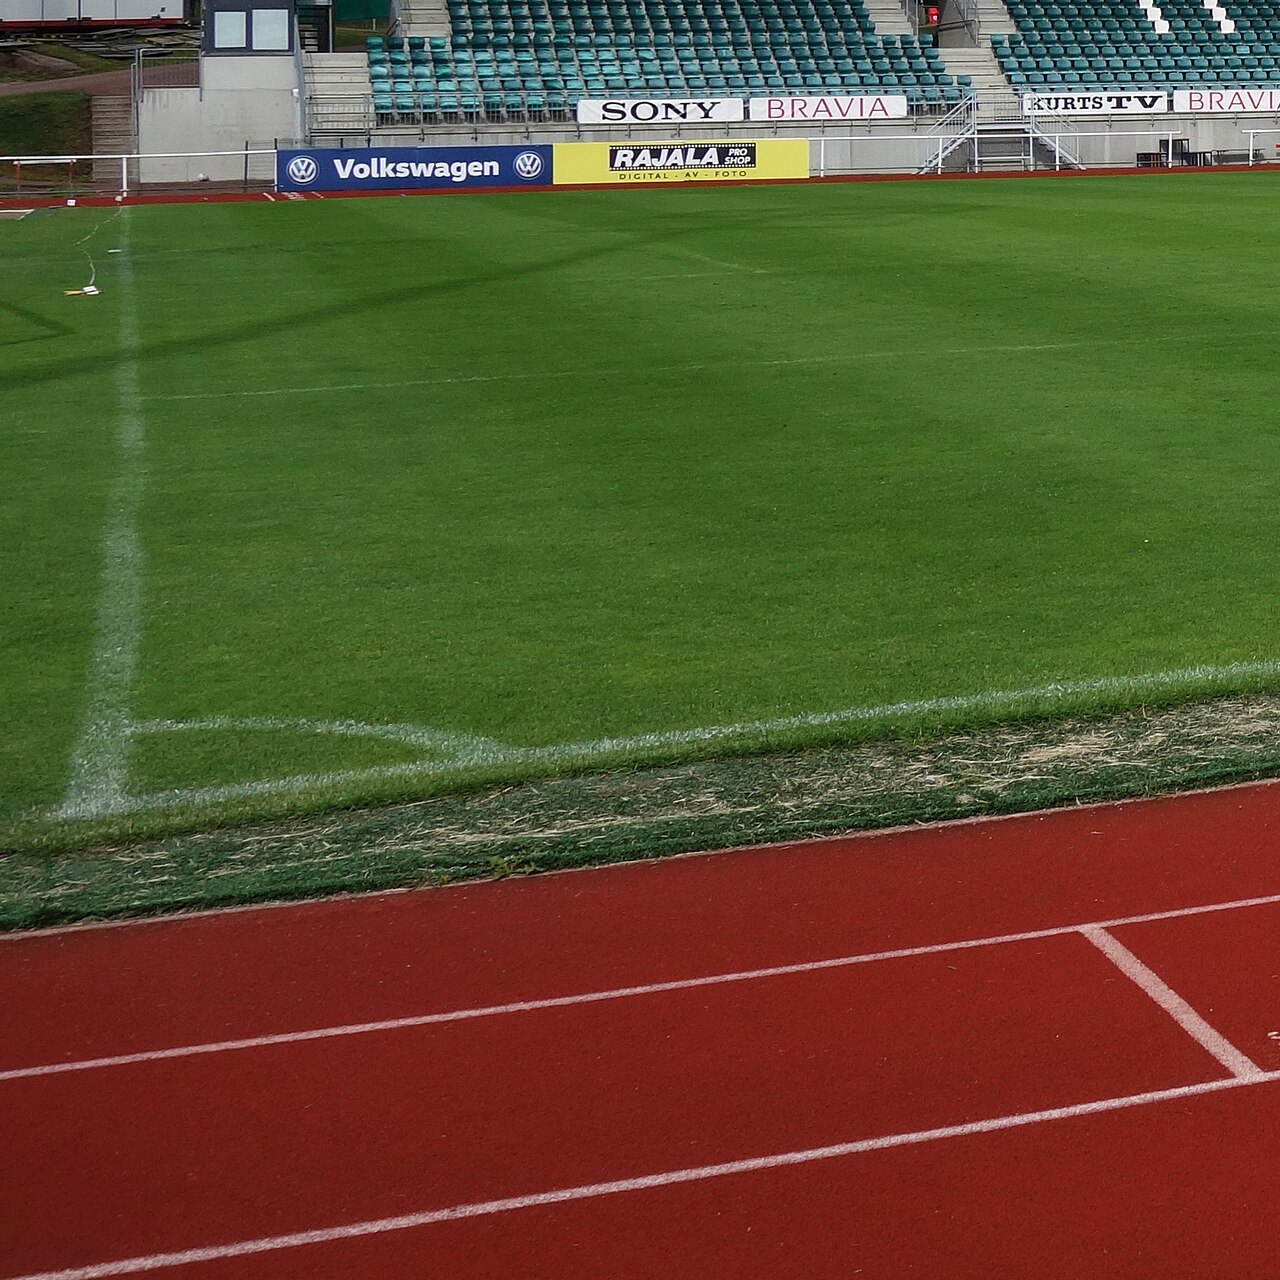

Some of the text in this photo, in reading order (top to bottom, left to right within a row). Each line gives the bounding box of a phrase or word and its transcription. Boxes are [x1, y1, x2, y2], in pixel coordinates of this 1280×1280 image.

[602, 101, 721, 121] SONY
[768, 98, 889, 119] BRAVIA
[1027, 95, 1163, 110] KURTS TV
[614, 146, 720, 168] RAJALA
[724, 155, 752, 166] SHOP
[728, 148, 747, 157] PRO
[333, 157, 500, 182] Volkswagen
[619, 173, 669, 181] DIGITAL
[715, 170, 748, 178] FOTO
